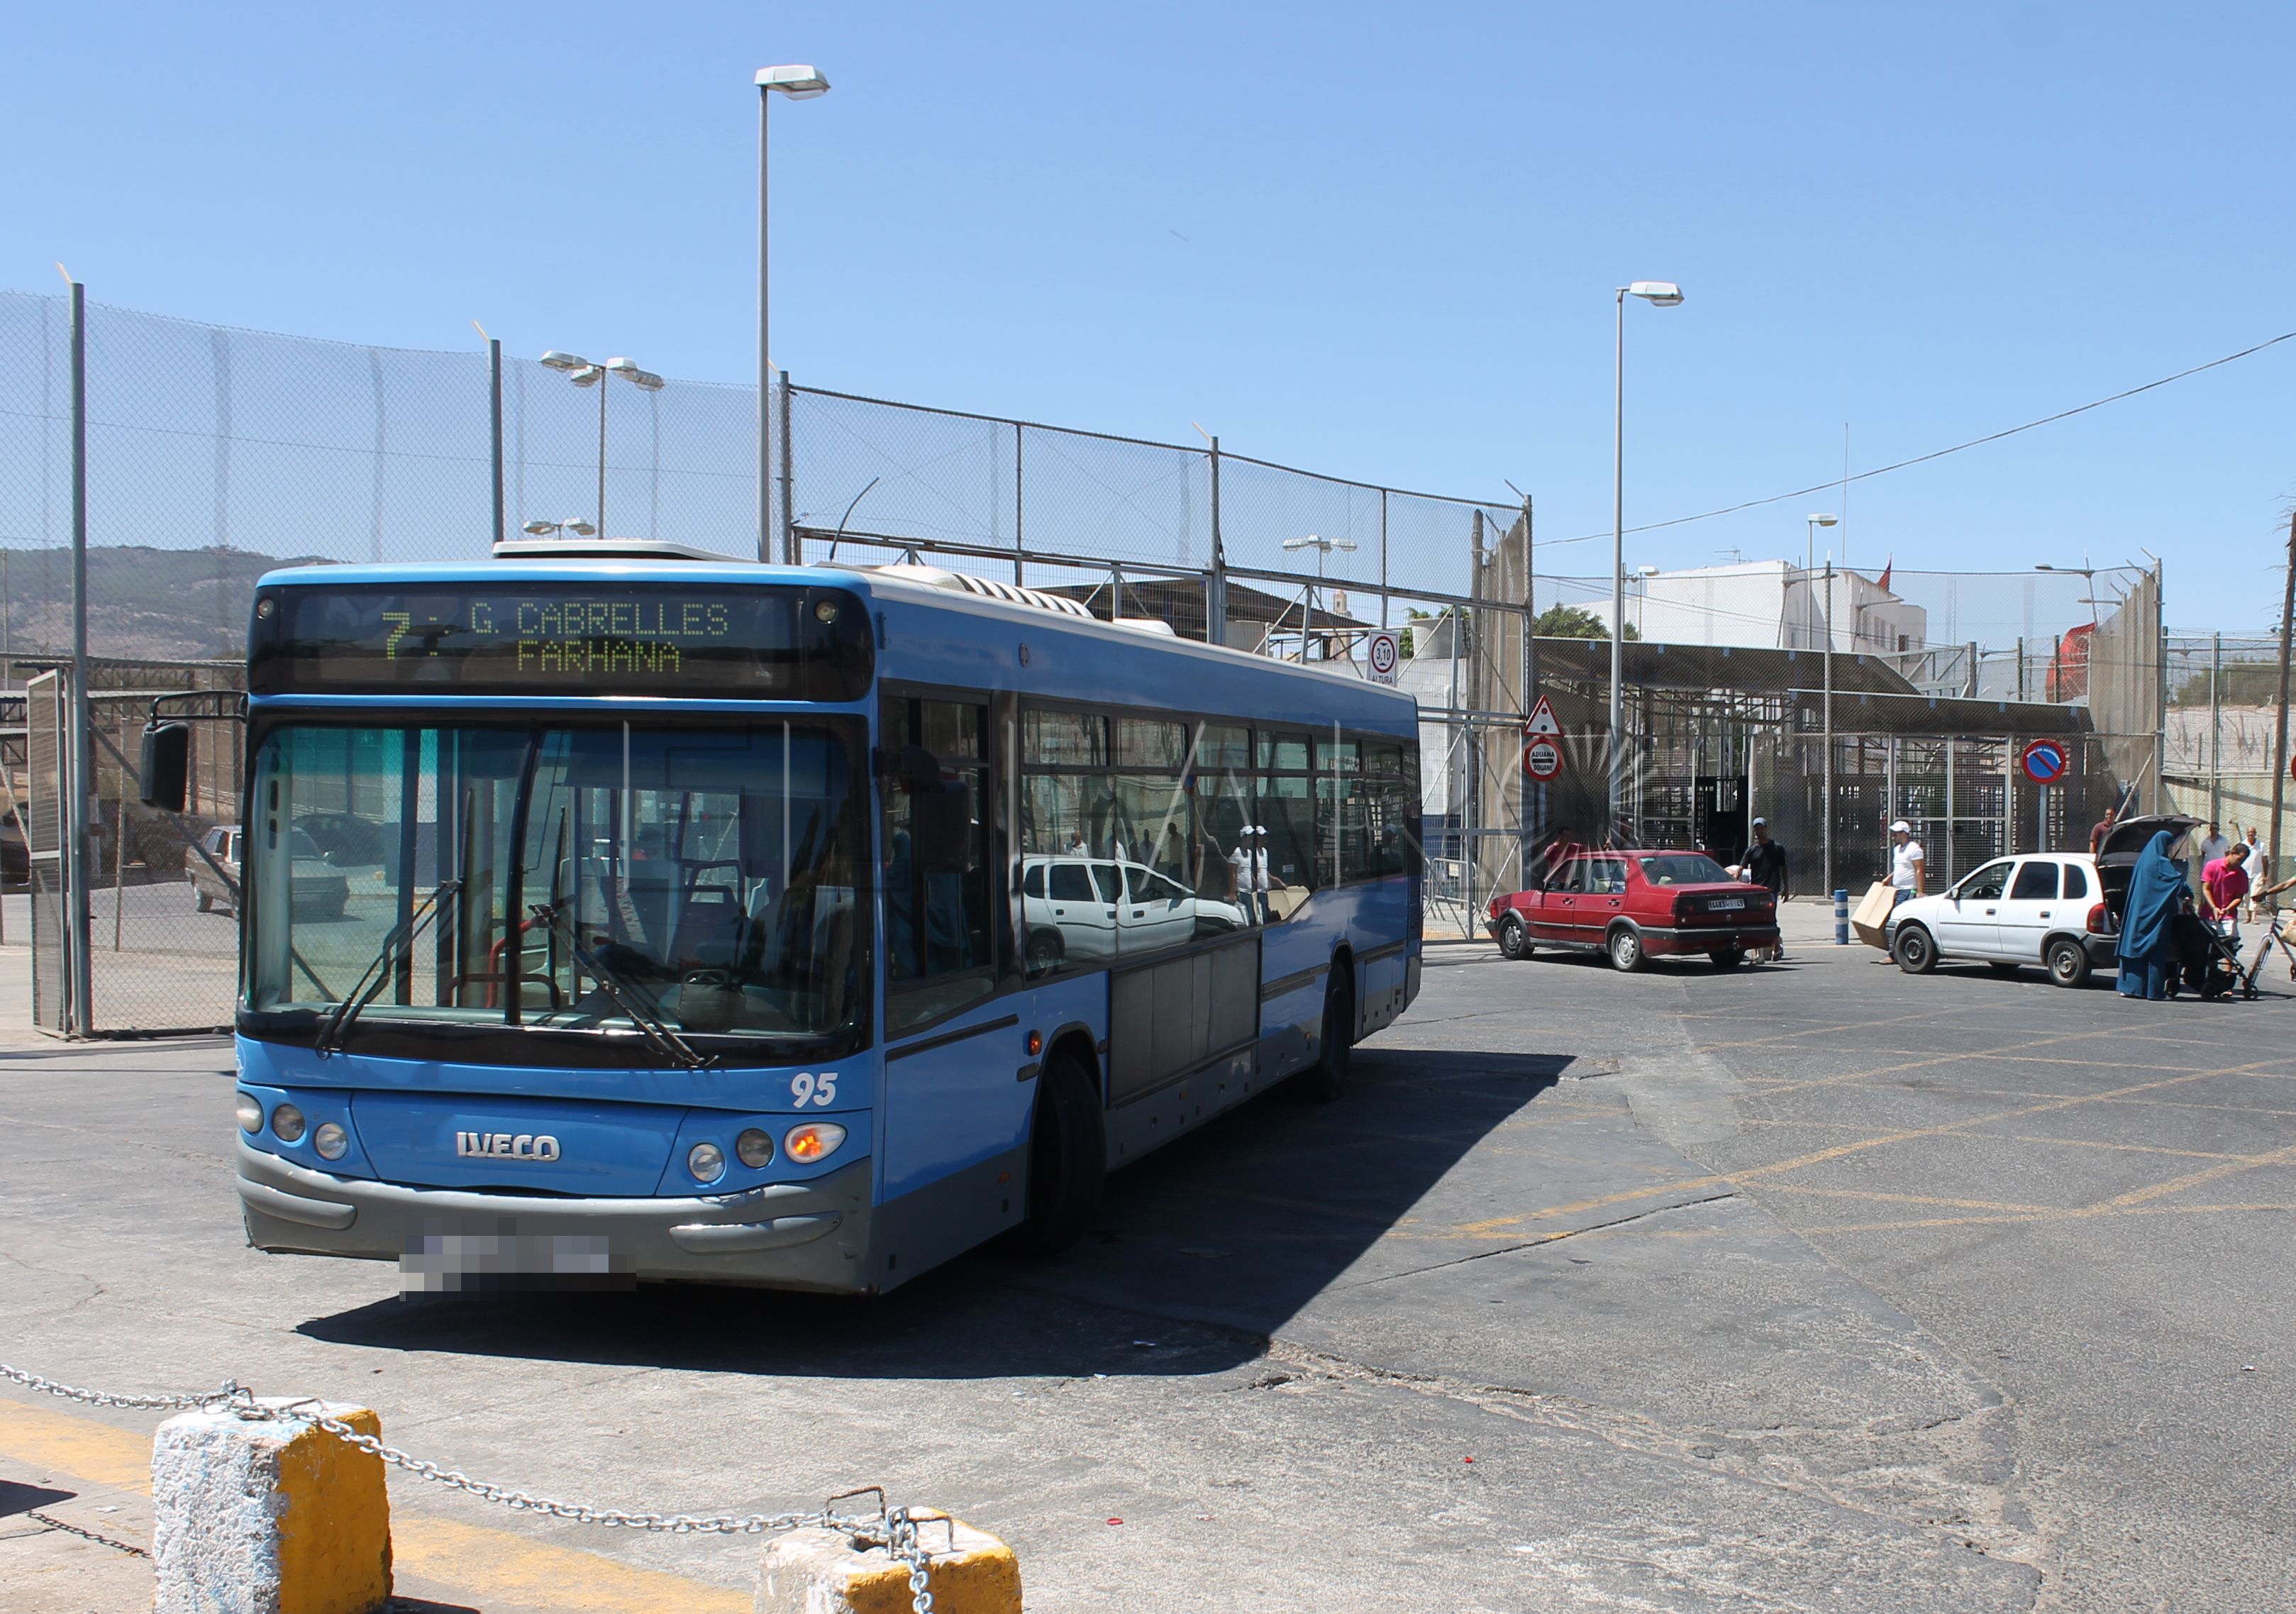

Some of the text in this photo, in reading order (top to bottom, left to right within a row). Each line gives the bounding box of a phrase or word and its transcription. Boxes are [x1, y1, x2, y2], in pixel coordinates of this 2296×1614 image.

[382, 612, 410, 660] 7
[471, 602, 728, 636] G. CABRELLES
[518, 639, 680, 673] FARHANA
[1376, 648, 1391, 662] 3,10
[792, 1072, 838, 1108] 95
[456, 1132, 562, 1162] IVECO
